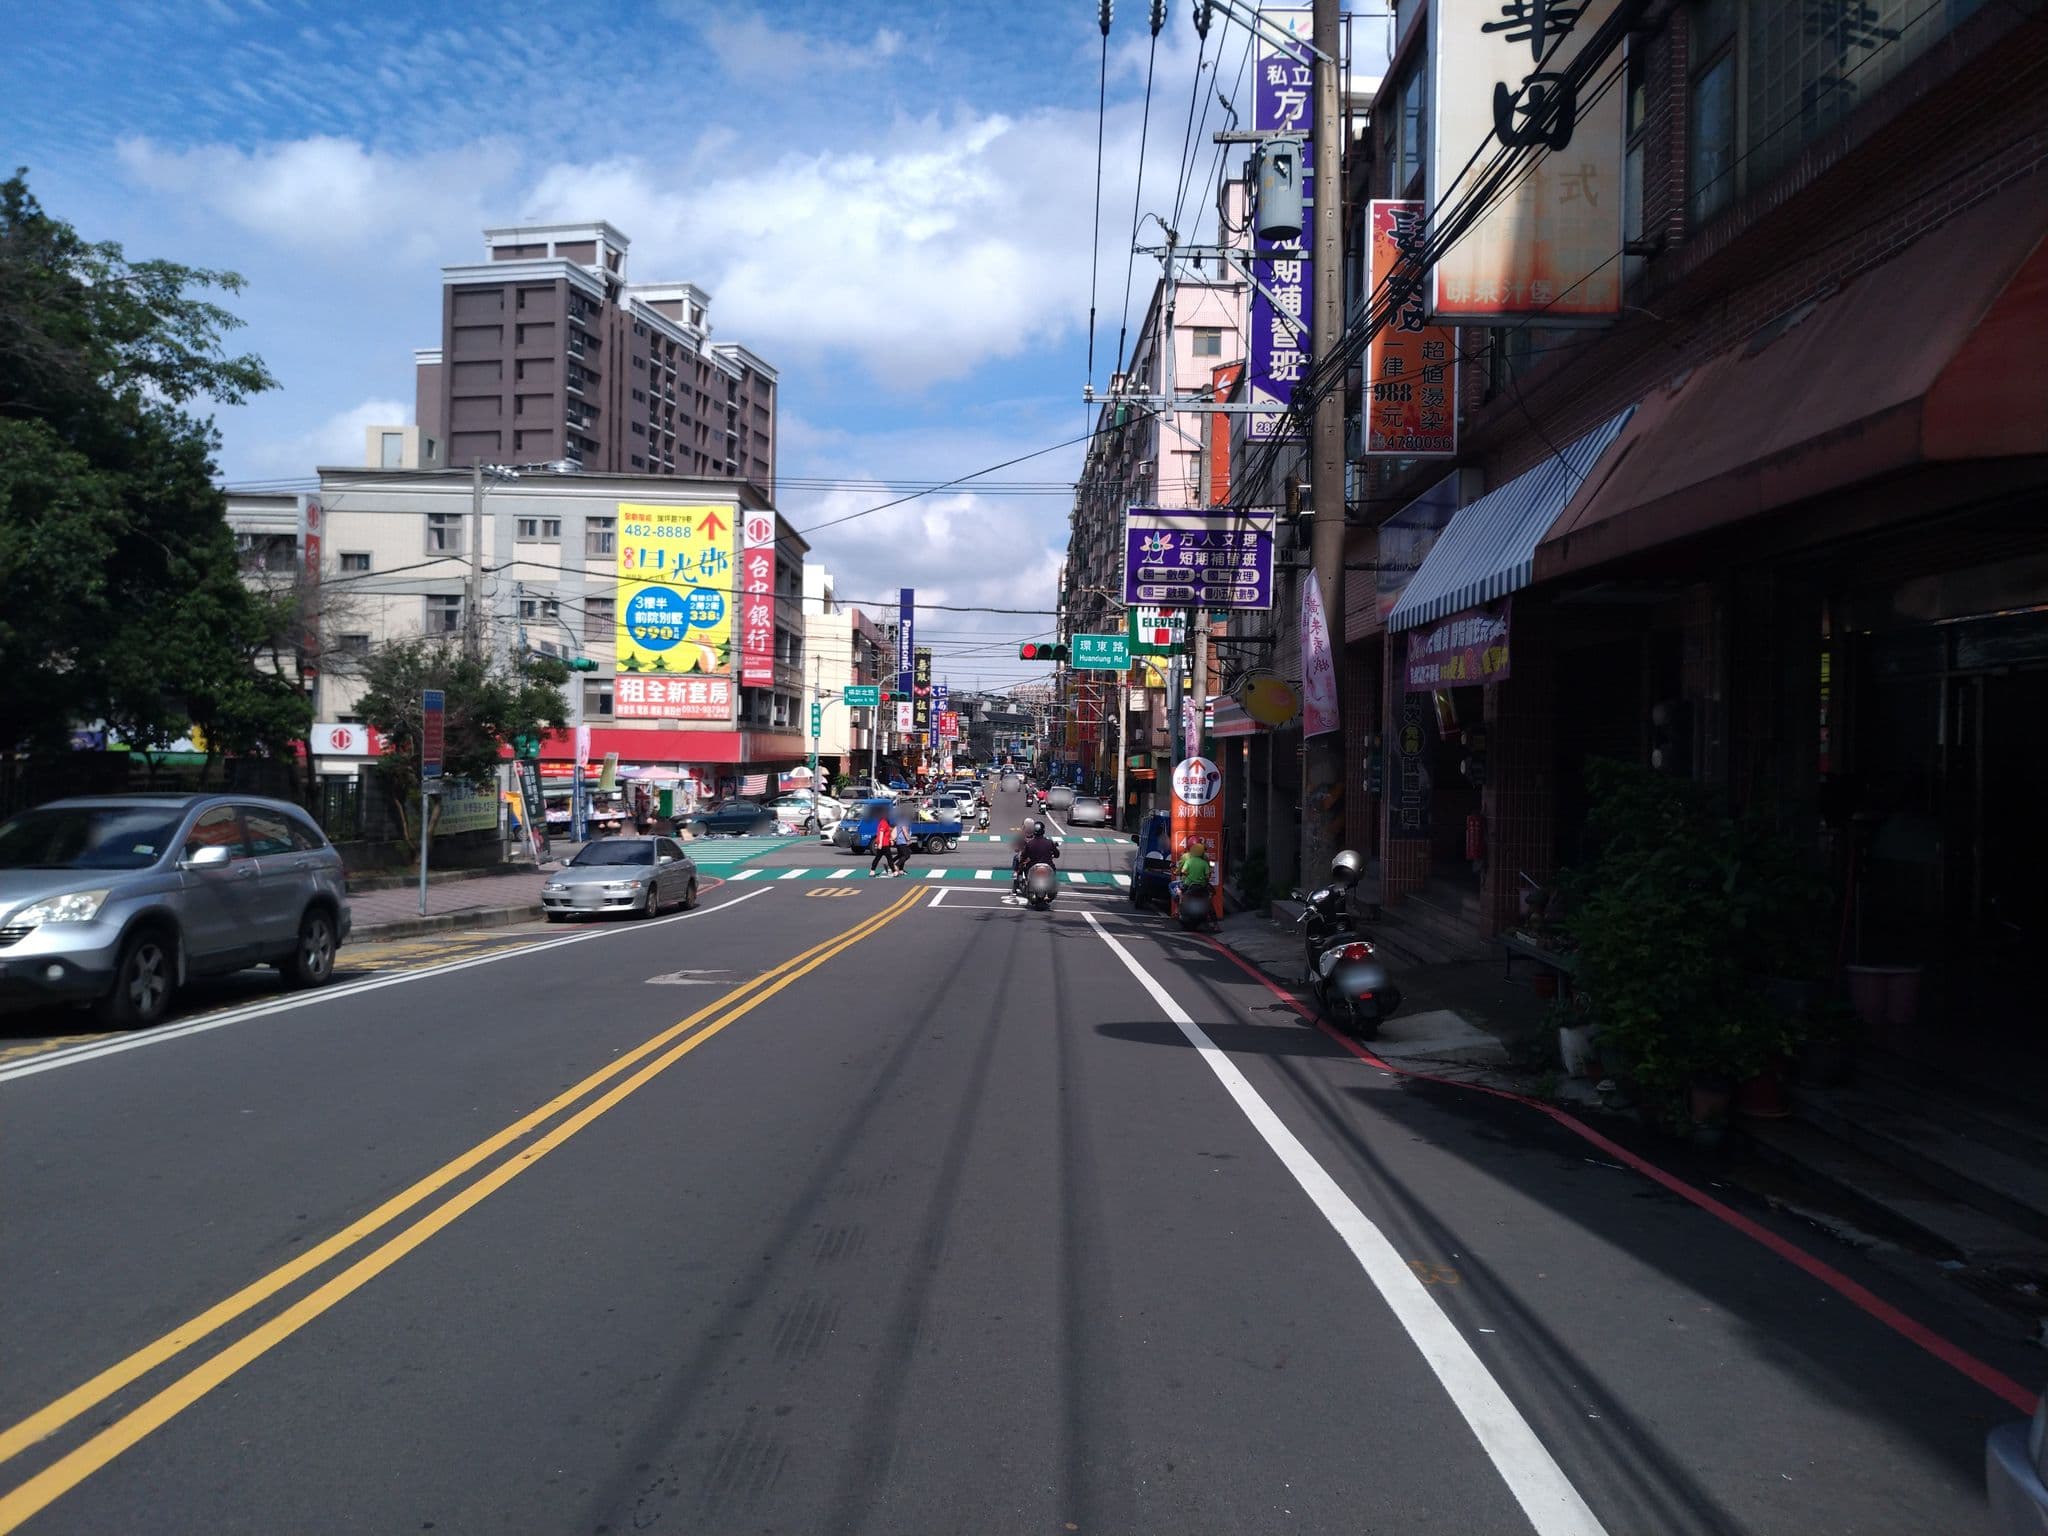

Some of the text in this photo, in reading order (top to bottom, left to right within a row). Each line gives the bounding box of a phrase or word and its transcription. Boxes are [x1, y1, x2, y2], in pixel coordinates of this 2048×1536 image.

[1266, 65, 1313, 86] 私立
[1420, 340, 1445, 431] 超值燙染
[1387, 435, 1452, 450] 4780056
[624, 524, 692, 538] 482-8888
[1180, 533, 1258, 548] 方人文理
[747, 555, 771, 653] 台中銀行
[901, 620, 912, 672] Panasonic
[1080, 640, 1125, 653] 環東路
[619, 679, 730, 704] 租全新套房
